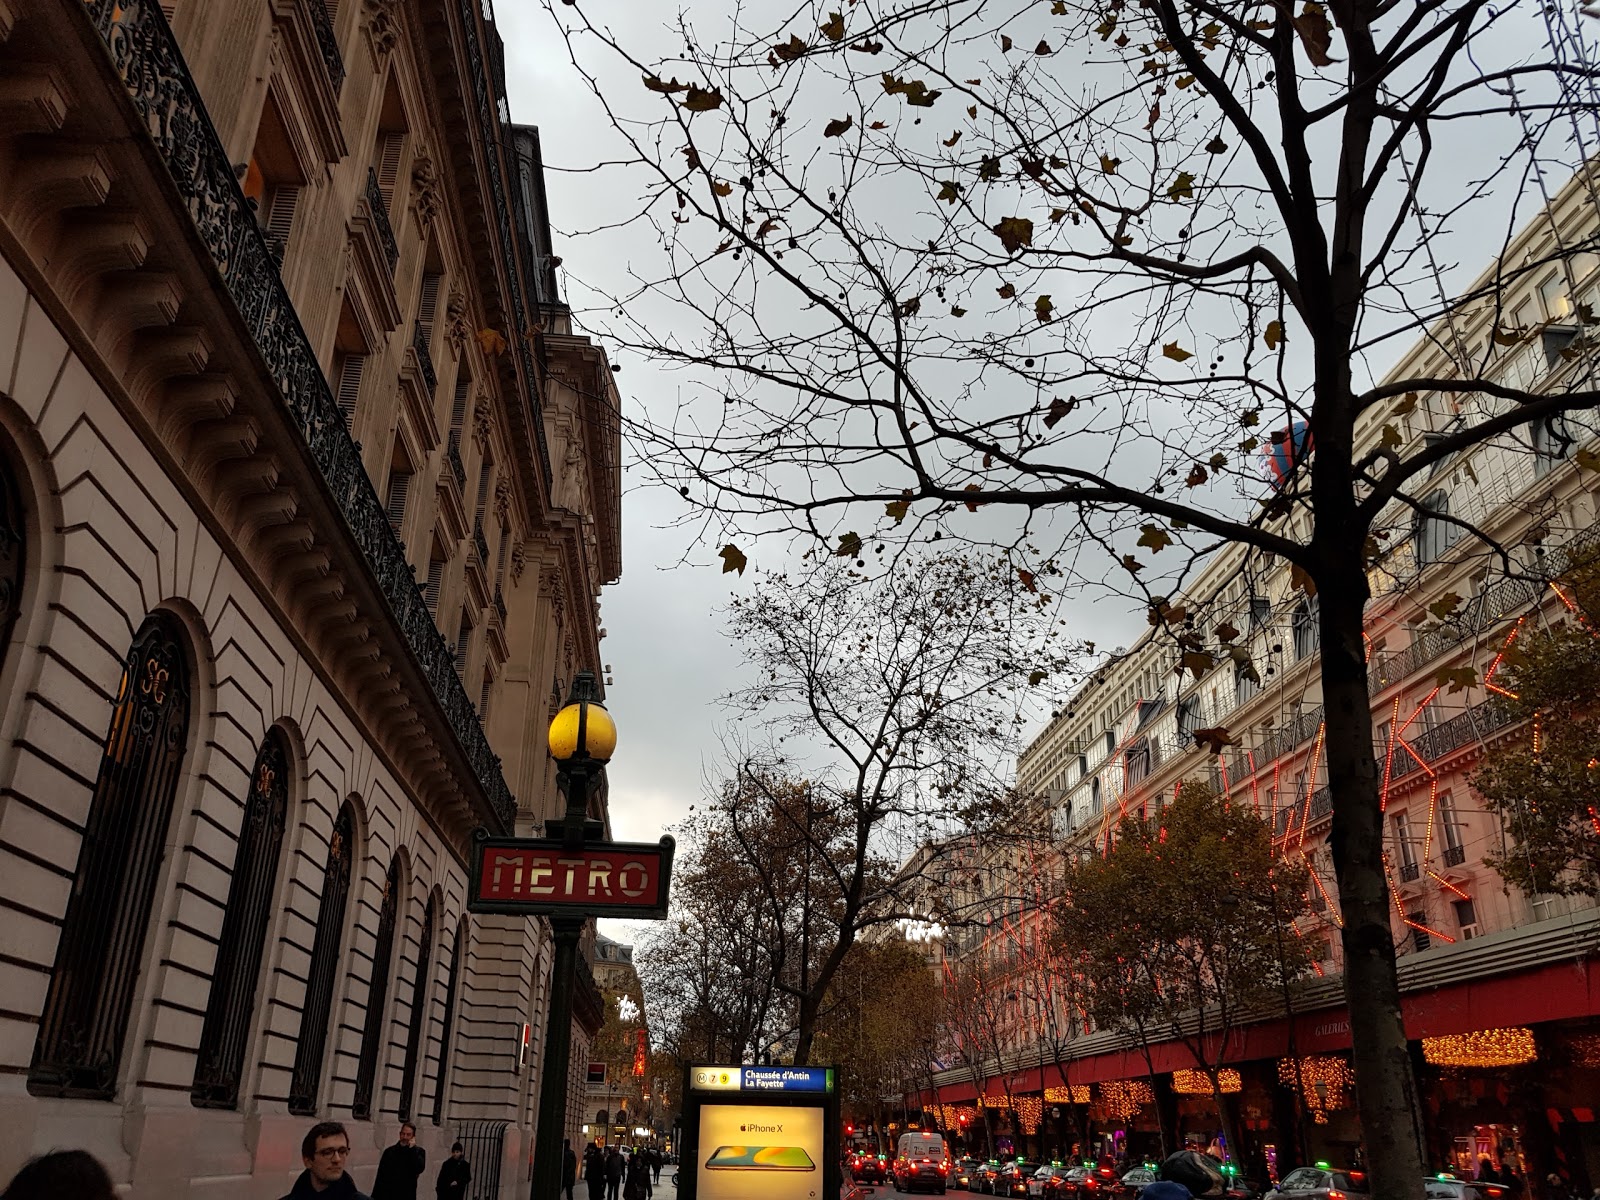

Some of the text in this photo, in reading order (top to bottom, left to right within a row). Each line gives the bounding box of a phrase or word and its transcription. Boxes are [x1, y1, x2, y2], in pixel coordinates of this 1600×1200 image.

[492, 855, 649, 897] METRO
[745, 1070, 810, 1080] Chaussée d'Antin
[745, 1079, 785, 1089] La Fayette
[747, 1124, 783, 1133] iPhone X
